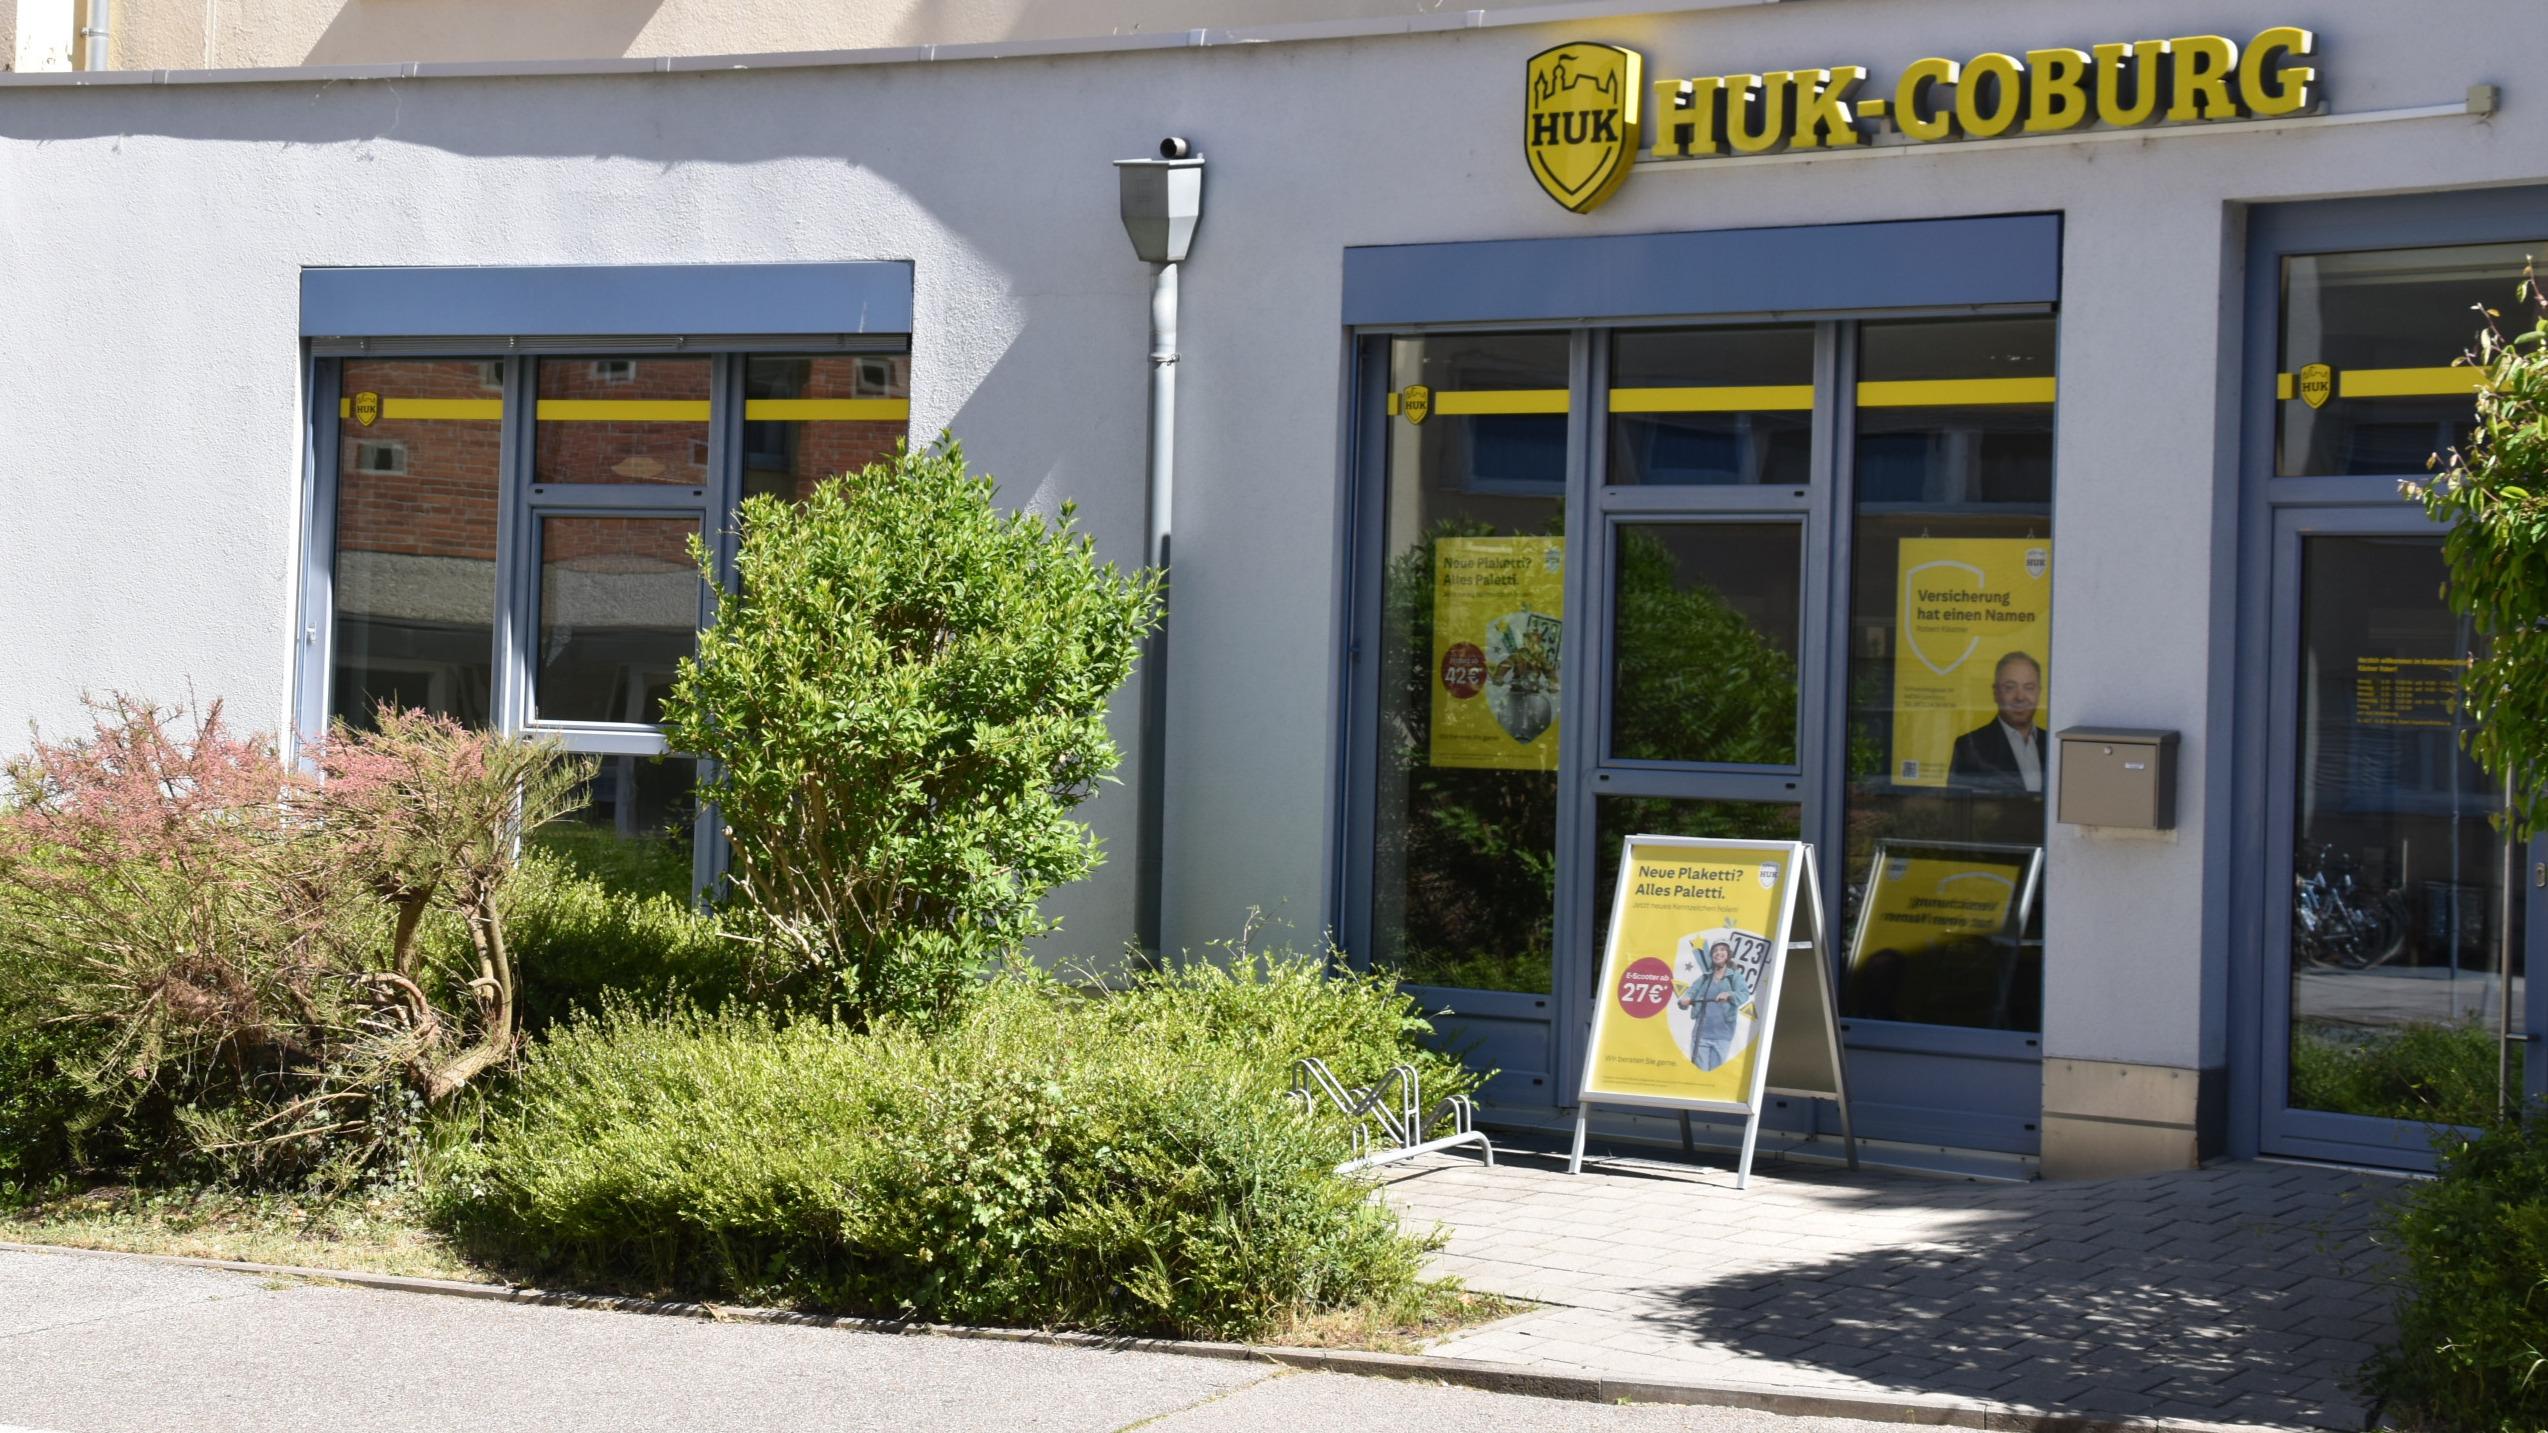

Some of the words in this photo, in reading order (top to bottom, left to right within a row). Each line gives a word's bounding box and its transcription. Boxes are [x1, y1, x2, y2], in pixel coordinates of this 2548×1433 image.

[1651, 26, 2313, 157] HUK-COBURG
[1531, 109, 1618, 146] HUK
[2302, 381, 2328, 392] HUK
[357, 405, 376, 413] HUK
[1405, 400, 1426, 410] HUK
[1443, 557, 1473, 568] Neue
[2026, 558, 2046, 567] HUK
[1443, 574, 1473, 585] Alles
[1917, 589, 2010, 606] Versicherung
[1917, 607, 1940, 620] hat
[1943, 608, 1981, 620] einen
[1985, 609, 2035, 622] Namen
[1639, 866, 1675, 878] Neue
[1678, 867, 1743, 882] Plaketti?
[1635, 884, 1670, 896] Alles
[1674, 885, 1725, 899] Paletti.
[1733, 937, 1764, 964] 123
